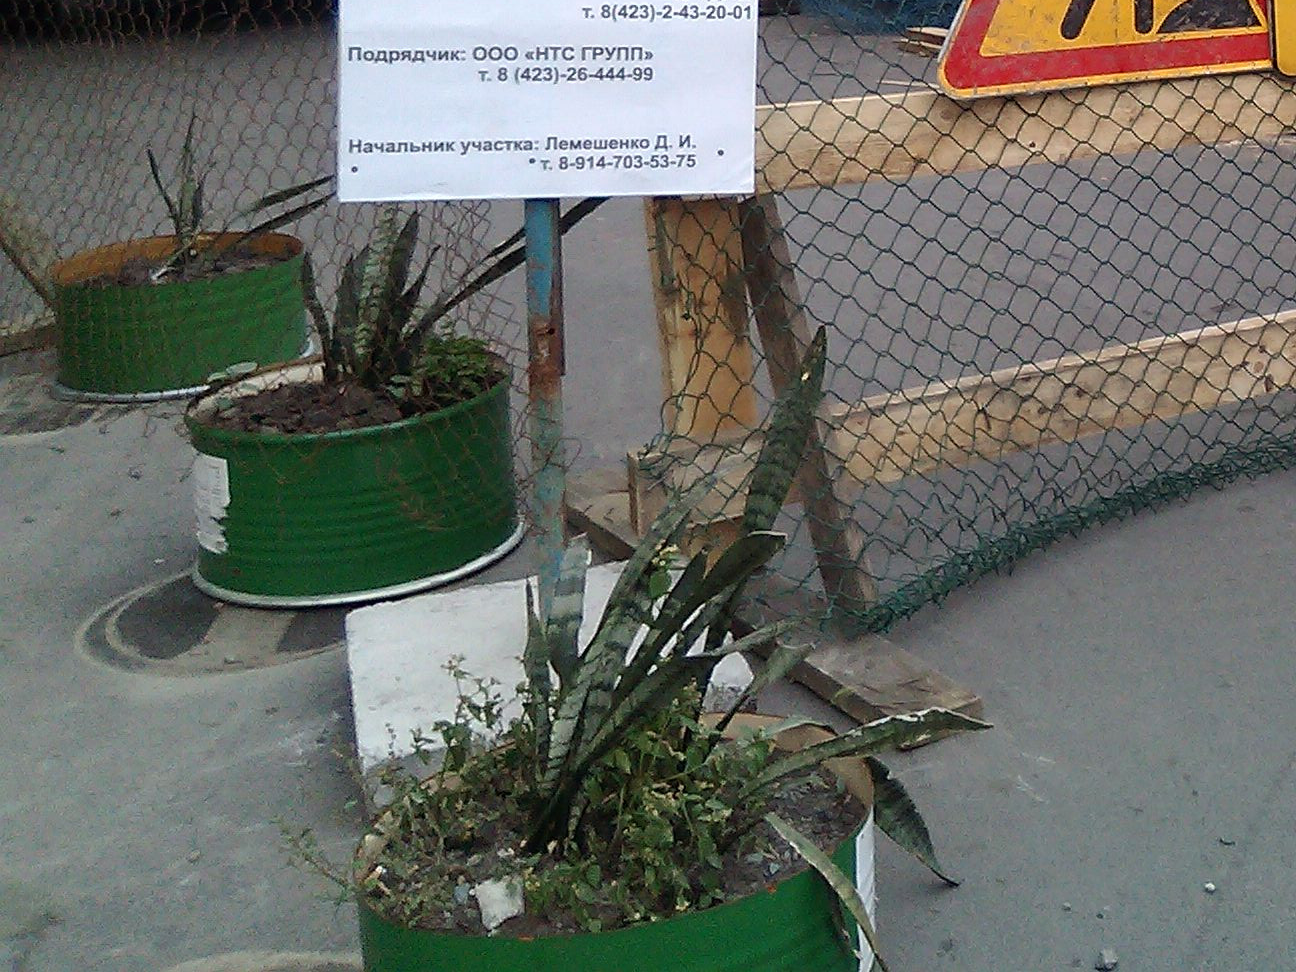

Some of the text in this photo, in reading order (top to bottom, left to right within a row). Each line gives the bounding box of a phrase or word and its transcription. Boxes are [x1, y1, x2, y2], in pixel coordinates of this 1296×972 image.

[601, 5, 750, 22] 8(423)-2-43-20-01
[348, 46, 653, 64] Подрядчик: ООО «НТС ГРУПП»
[498, 68, 508, 81] 8
[514, 67, 653, 84] (423)-26-444-99
[349, 135, 696, 155] Начальник участка: Лемешенко Д. И.
[559, 154, 696, 170] 8-914-703-53-75
